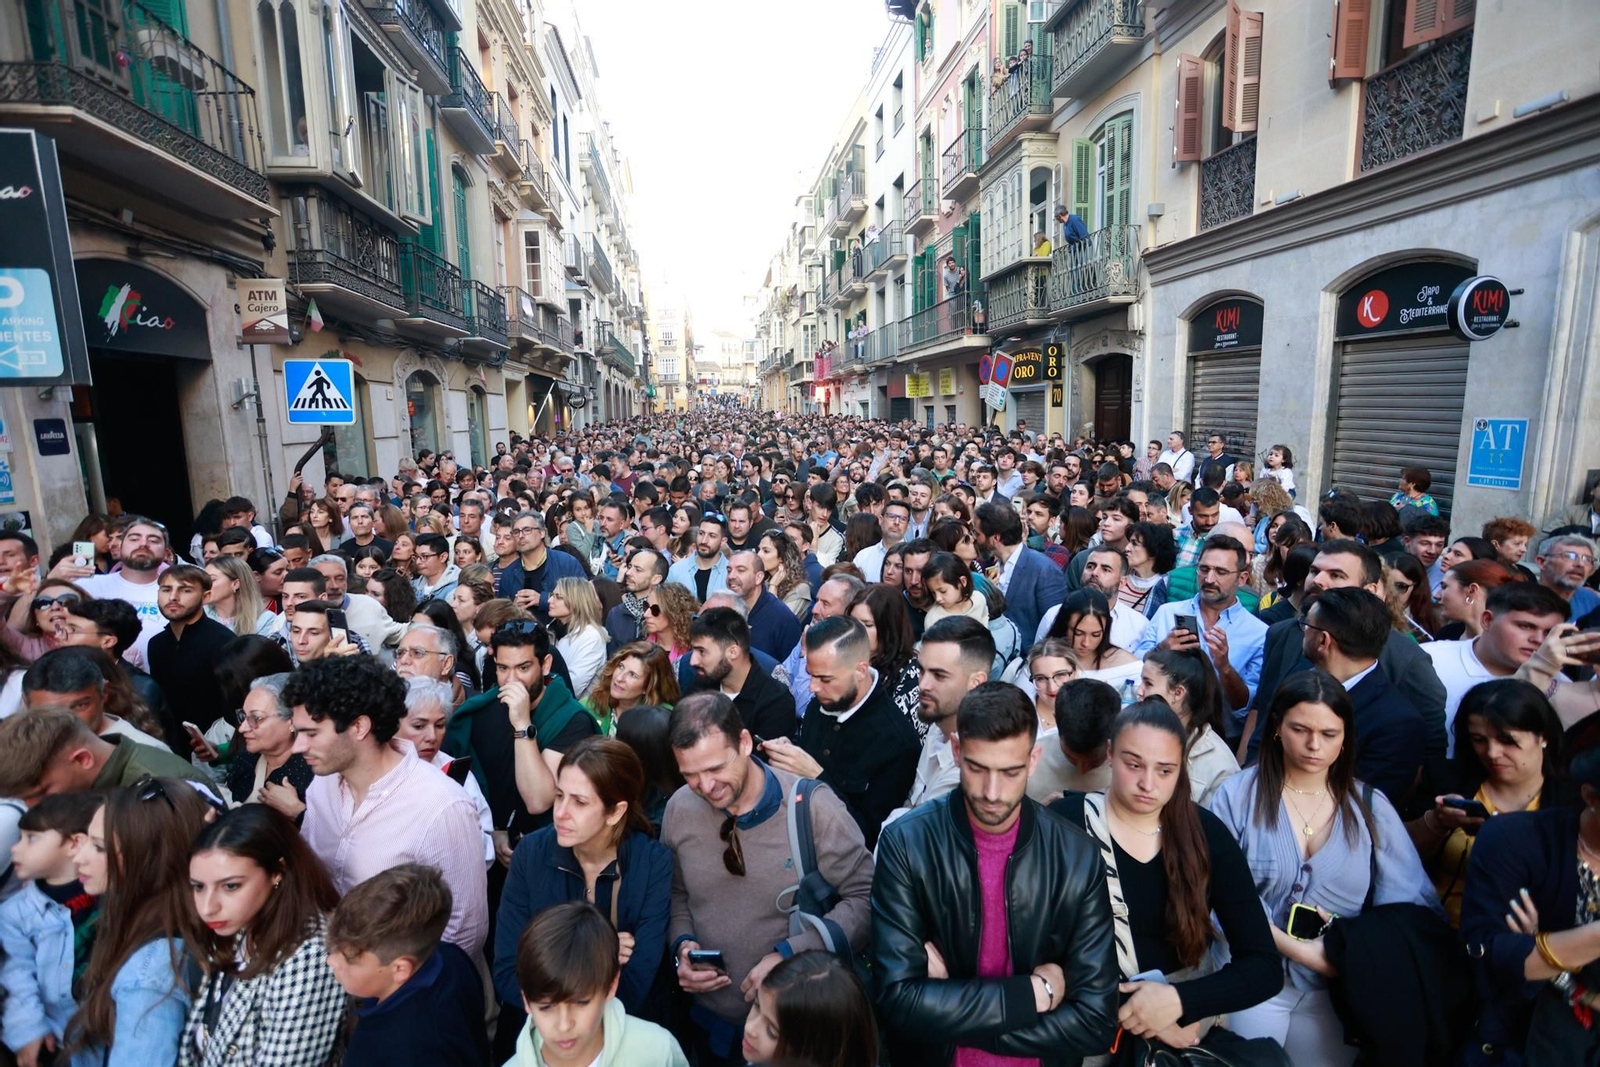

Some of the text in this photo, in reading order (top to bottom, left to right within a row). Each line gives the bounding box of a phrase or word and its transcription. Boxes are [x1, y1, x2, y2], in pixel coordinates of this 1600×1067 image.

[247, 303, 279, 313] Cajero
[248, 290, 277, 301] ATM
[1427, 297, 1433, 306] &
[1473, 289, 1504, 314] KIMI
[122, 299, 175, 330] Ciao
[1216, 306, 1241, 333] KIMI
[1363, 296, 1380, 322] K
[1014, 365, 1035, 379] ORO
[1047, 345, 1058, 377] ORO
[1053, 388, 1062, 403] 70
[1479, 424, 1520, 451] AT
